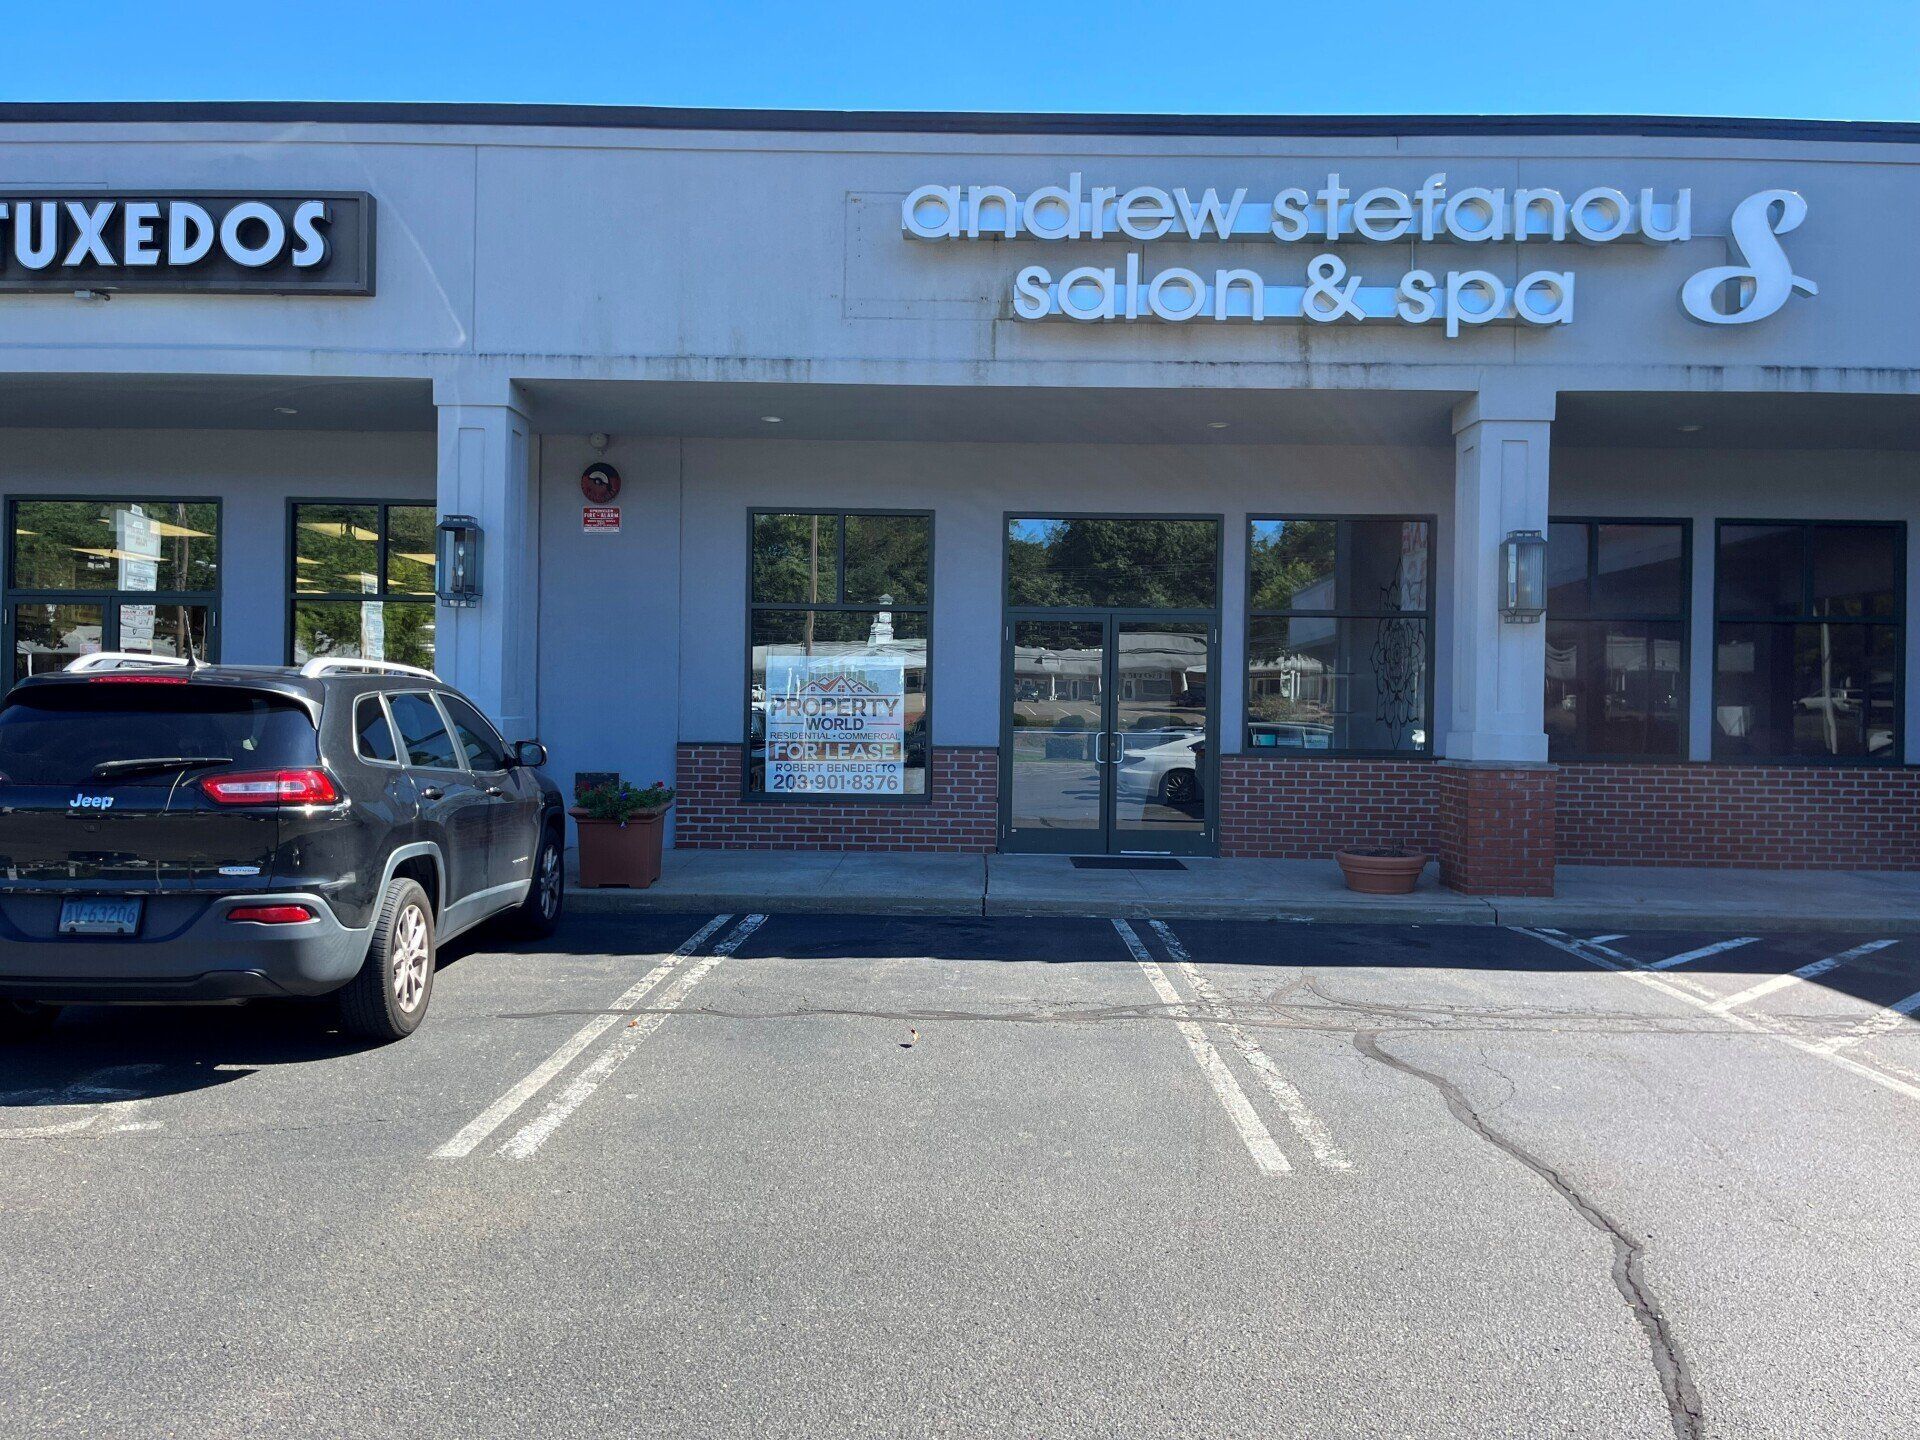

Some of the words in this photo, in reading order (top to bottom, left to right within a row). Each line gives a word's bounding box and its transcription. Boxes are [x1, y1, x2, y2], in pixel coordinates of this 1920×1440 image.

[901, 171, 1248, 241] andrew
[1271, 172, 1691, 242] stefanou
[0, 200, 325, 269] UXEDOS
[1016, 252, 1265, 322] salon
[1303, 253, 1367, 323] &
[1399, 267, 1576, 337] spa
[770, 697, 900, 717] PROPERTY
[806, 717, 865, 731] WORLD
[770, 731, 831, 740] RESIDENTIAL
[838, 732, 900, 740] COMMERCIAL
[774, 742, 818, 760] FOR
[825, 743, 895, 760] LEASE
[775, 763, 823, 773] ROBERT
[827, 764, 896, 773] BENEDETTO
[69, 793, 114, 810] Jeep
